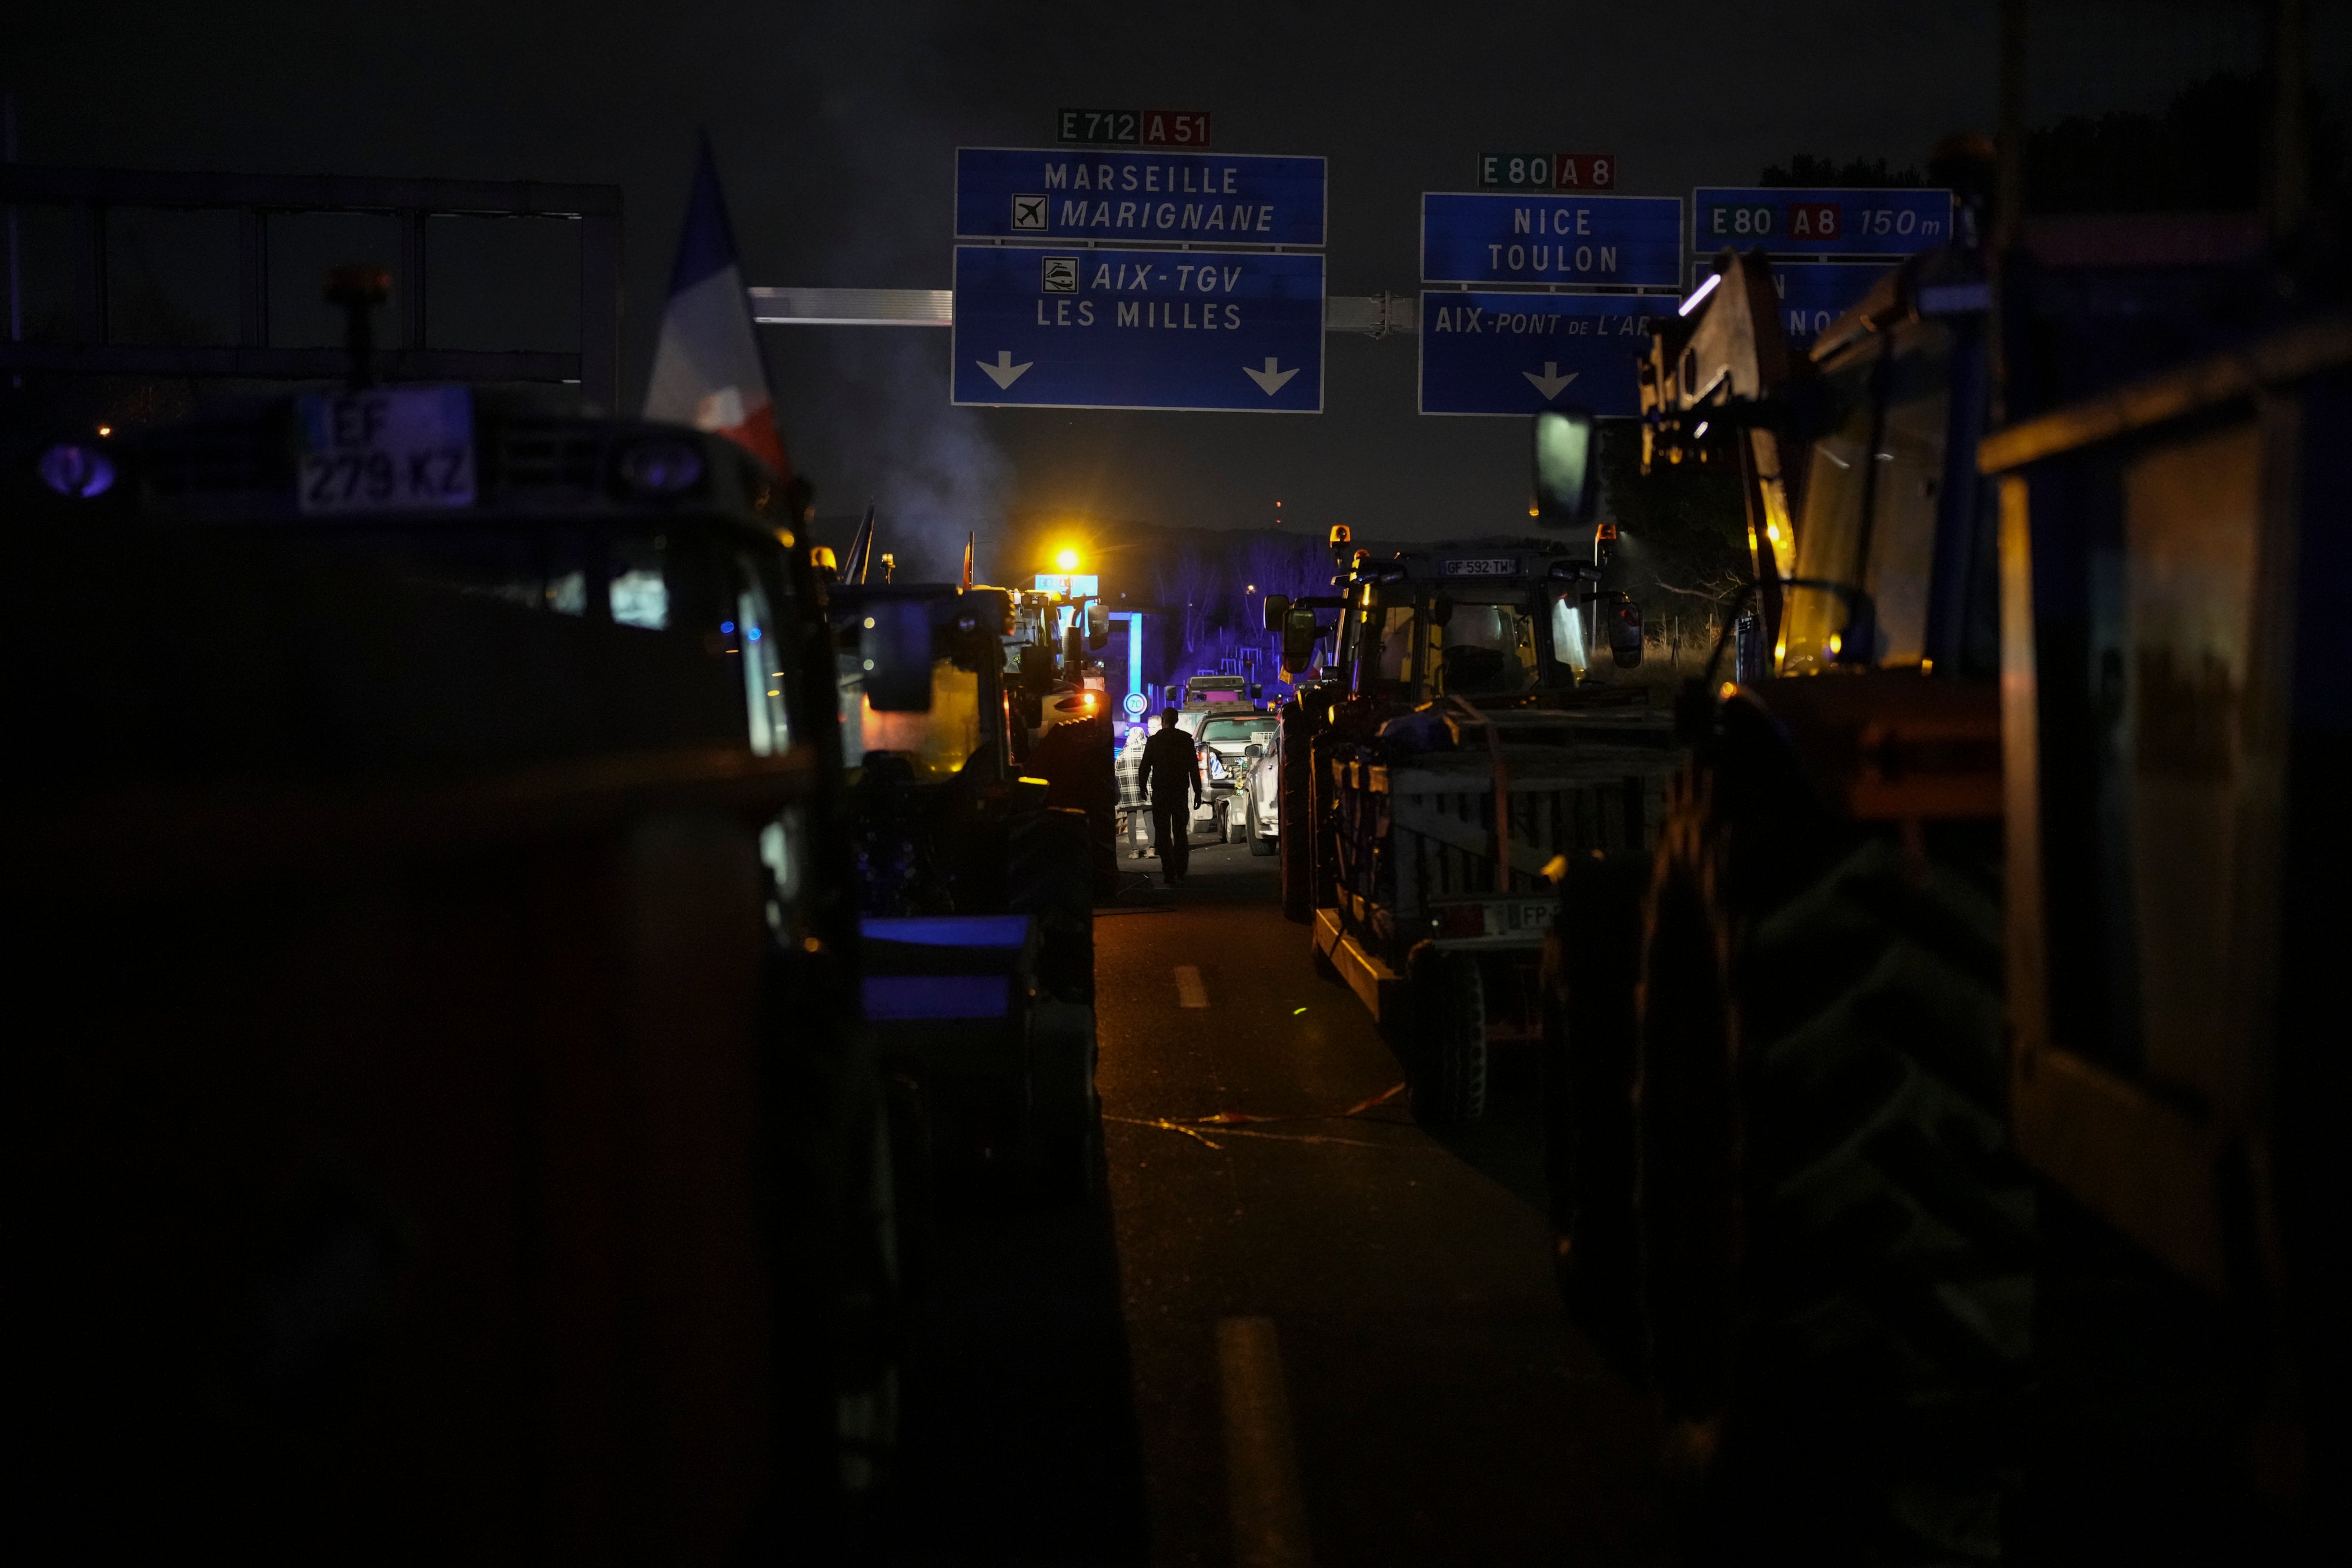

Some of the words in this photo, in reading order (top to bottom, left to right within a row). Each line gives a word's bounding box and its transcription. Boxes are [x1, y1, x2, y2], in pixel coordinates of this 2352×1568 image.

[1063, 112, 1077, 139] E
[1085, 113, 1135, 141] 712
[1148, 115, 1166, 141] A
[1174, 116, 1205, 142] 51
[1044, 163, 1238, 194] MARSEILLE
[1484, 157, 1498, 183] E
[1509, 158, 1548, 185] 80
[1561, 159, 1579, 185] A
[1593, 159, 1609, 186] 8
[1060, 200, 1274, 232] MARIGNANE
[1514, 208, 1591, 236] NICE
[1488, 244, 1617, 273] TOULON
[1091, 263, 1242, 293] AIX-TGV
[1037, 300, 1094, 327] LES
[1117, 302, 1241, 330] MILLES
[1568, 321, 1589, 335] DE
[1597, 315, 1668, 337] L'AR
[333, 399, 388, 447] EF
[309, 452, 395, 502] 279
[409, 447, 466, 495] KZ
[1466, 561, 1489, 573] 592
[1130, 700, 1142, 708] 70
